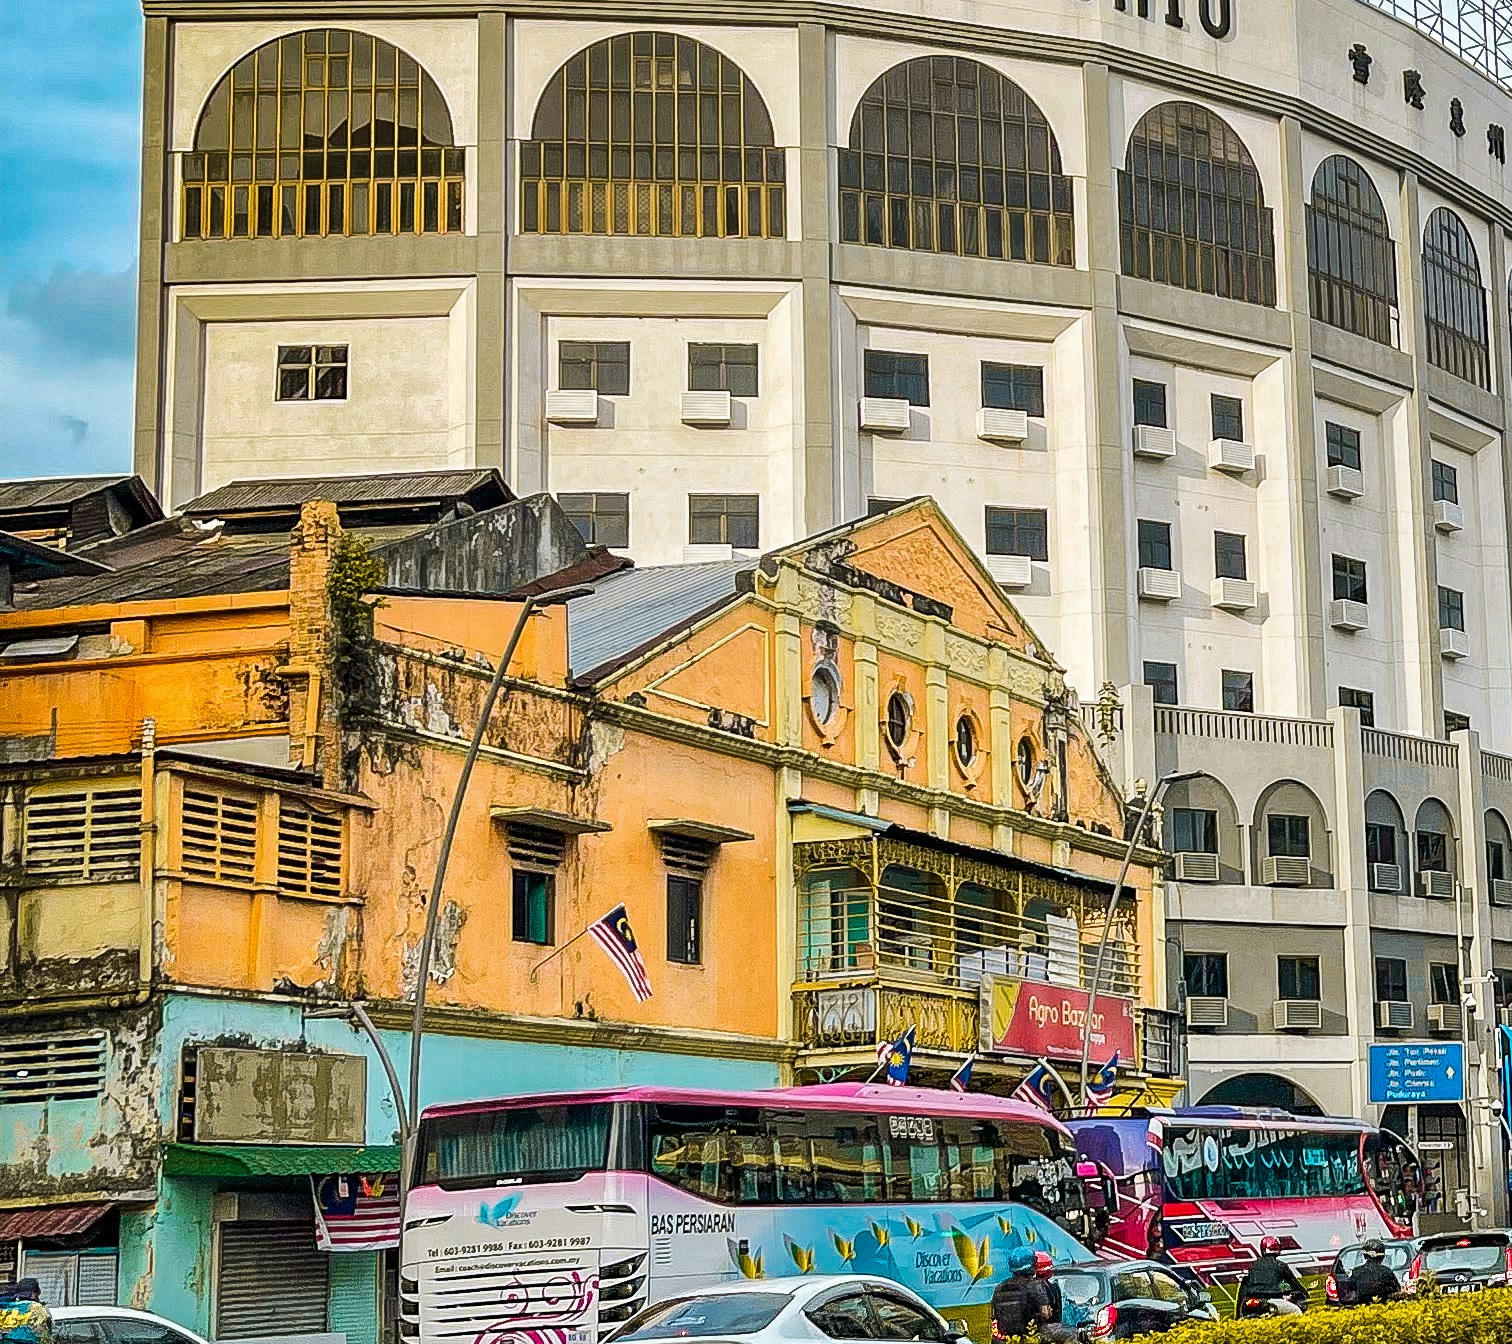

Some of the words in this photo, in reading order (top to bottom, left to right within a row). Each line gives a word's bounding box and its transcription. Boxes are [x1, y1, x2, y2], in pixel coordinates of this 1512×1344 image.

[1029, 995, 1059, 1028] Agro
[651, 1214, 674, 1235] BAS
[675, 1212, 736, 1234] PERSIARAN
[914, 1251, 951, 1268] Discover
[924, 1267, 964, 1284] Vacations
